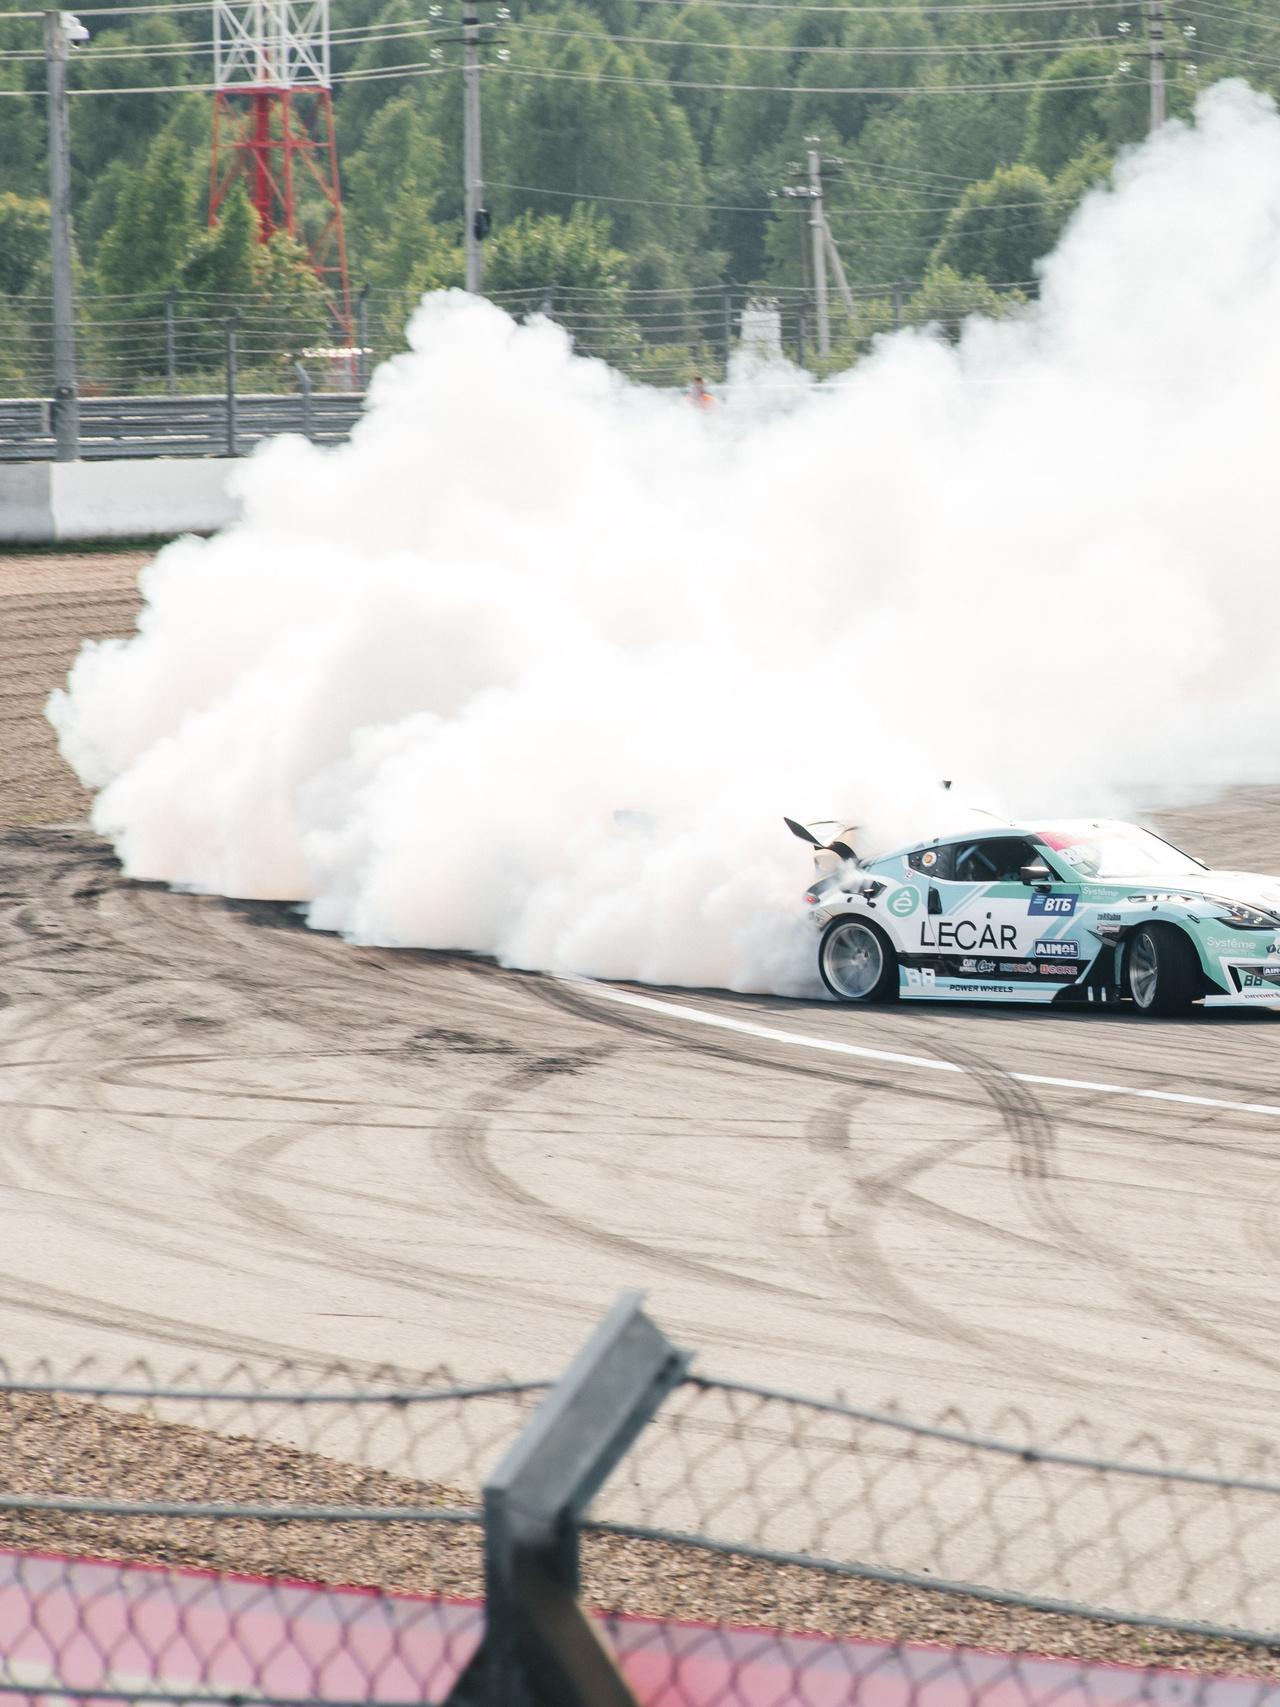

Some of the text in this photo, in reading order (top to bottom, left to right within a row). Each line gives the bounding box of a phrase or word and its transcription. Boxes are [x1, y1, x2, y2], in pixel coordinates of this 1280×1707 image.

[1043, 898, 1073, 912] ВТБ
[920, 920, 1018, 951] LECAR
[1036, 943, 1077, 955] AIMOL
[949, 984, 1013, 993] POWER WHEELS
